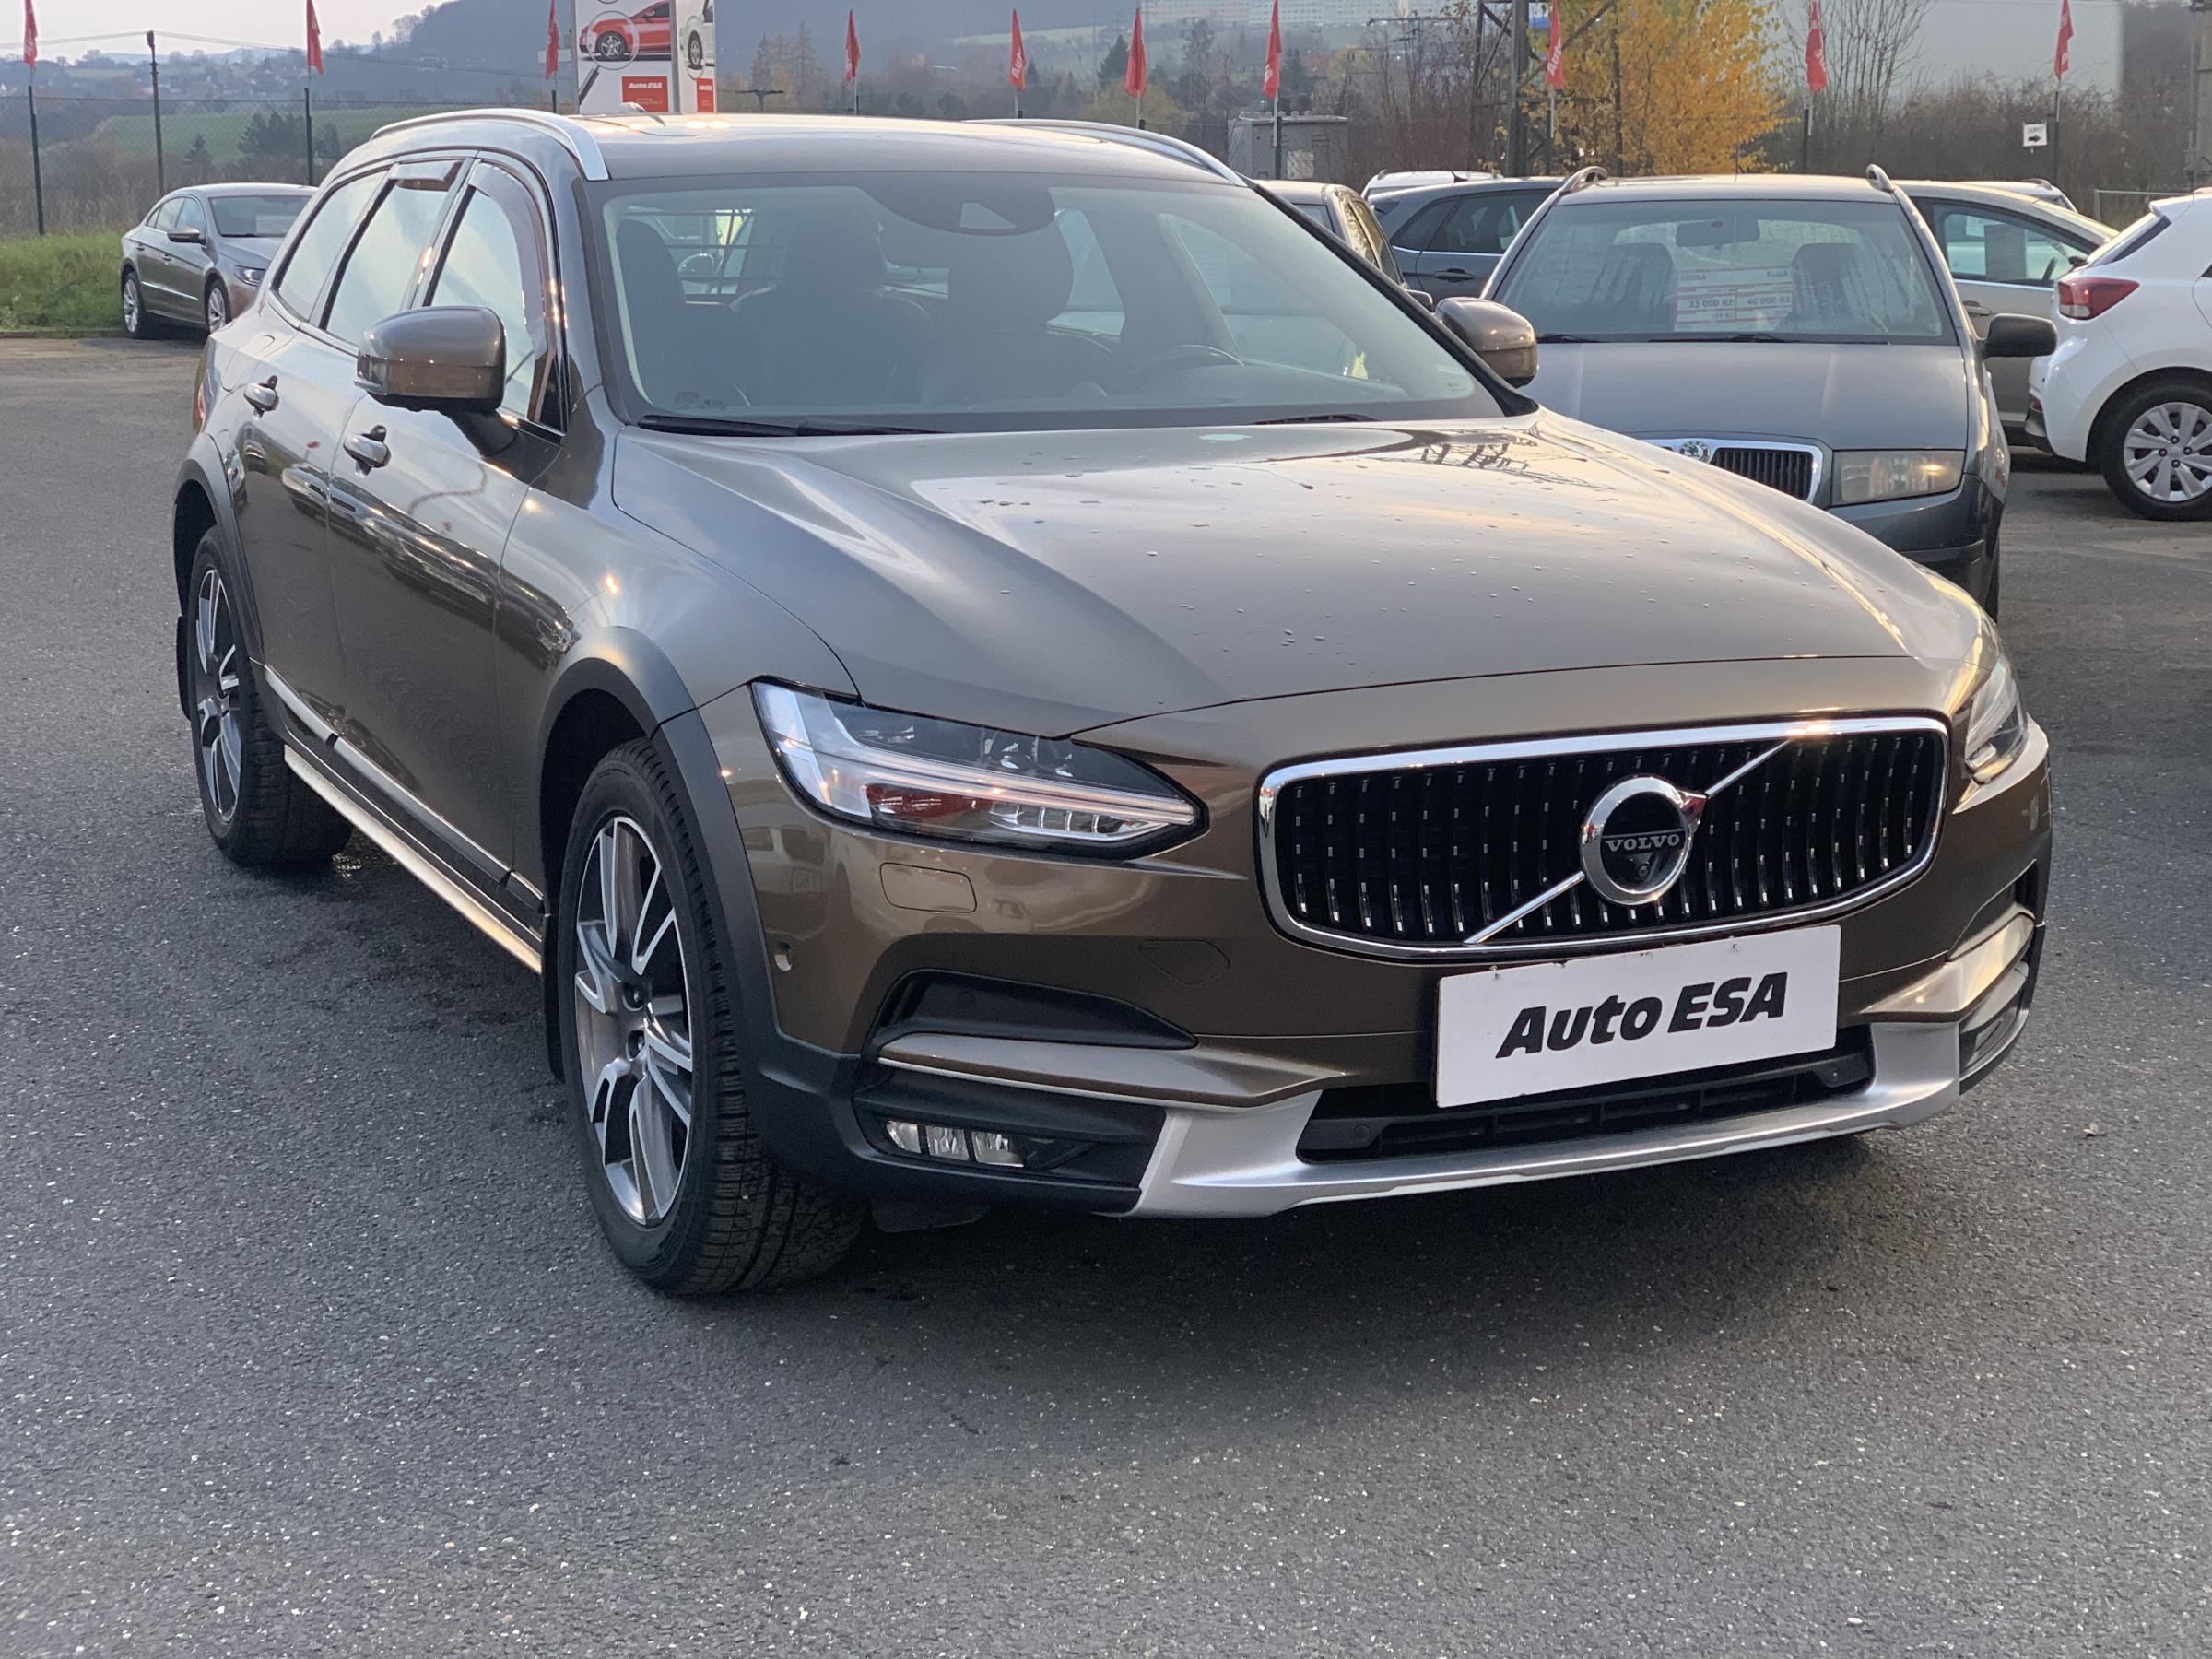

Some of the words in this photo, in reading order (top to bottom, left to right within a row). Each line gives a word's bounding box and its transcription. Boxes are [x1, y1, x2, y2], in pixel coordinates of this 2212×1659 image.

[1605, 834, 1680, 852] VOLVO
[1495, 995, 1663, 1059] Auto
[1667, 972, 1788, 1033] ESA
